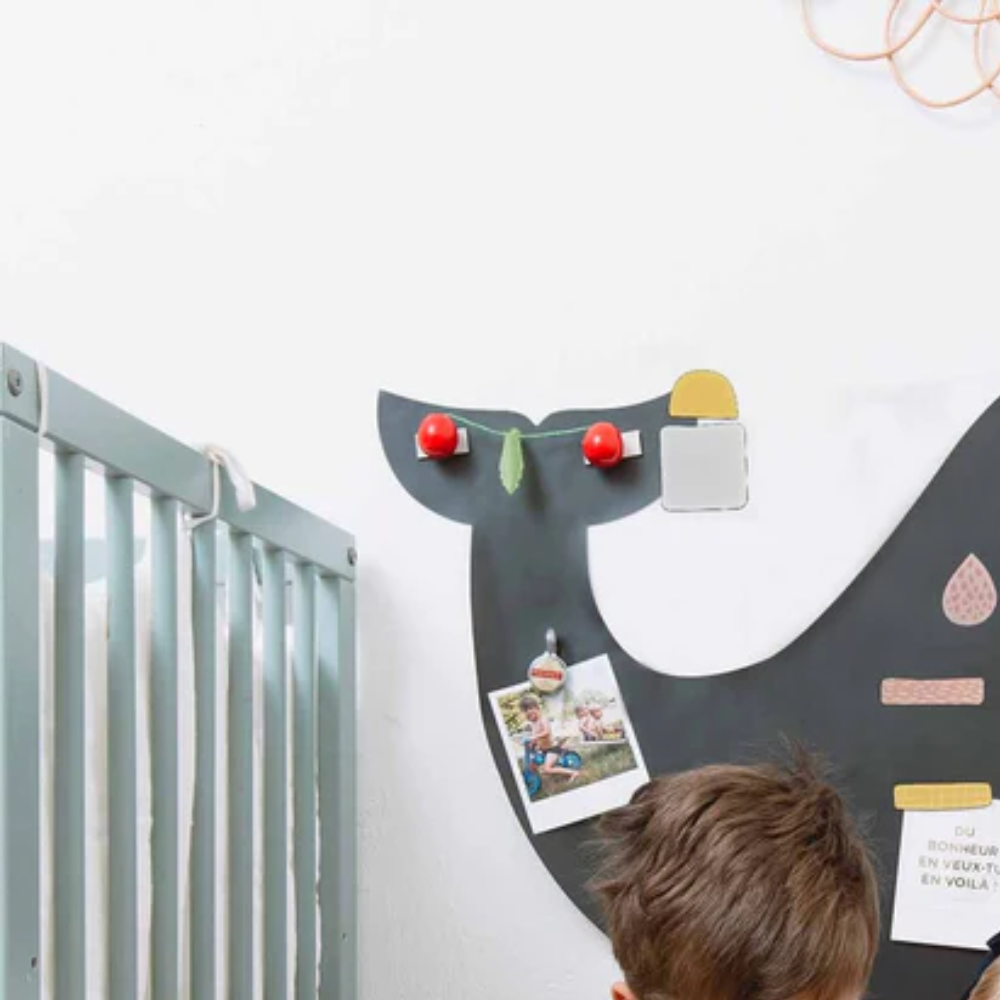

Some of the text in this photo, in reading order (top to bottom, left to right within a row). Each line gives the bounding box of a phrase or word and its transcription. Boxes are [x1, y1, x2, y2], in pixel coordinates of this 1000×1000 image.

[955, 826, 975, 838] DU
[928, 840, 999, 856] BONHEUR
[918, 856, 938, 868] EN
[921, 873, 941, 885] EN
